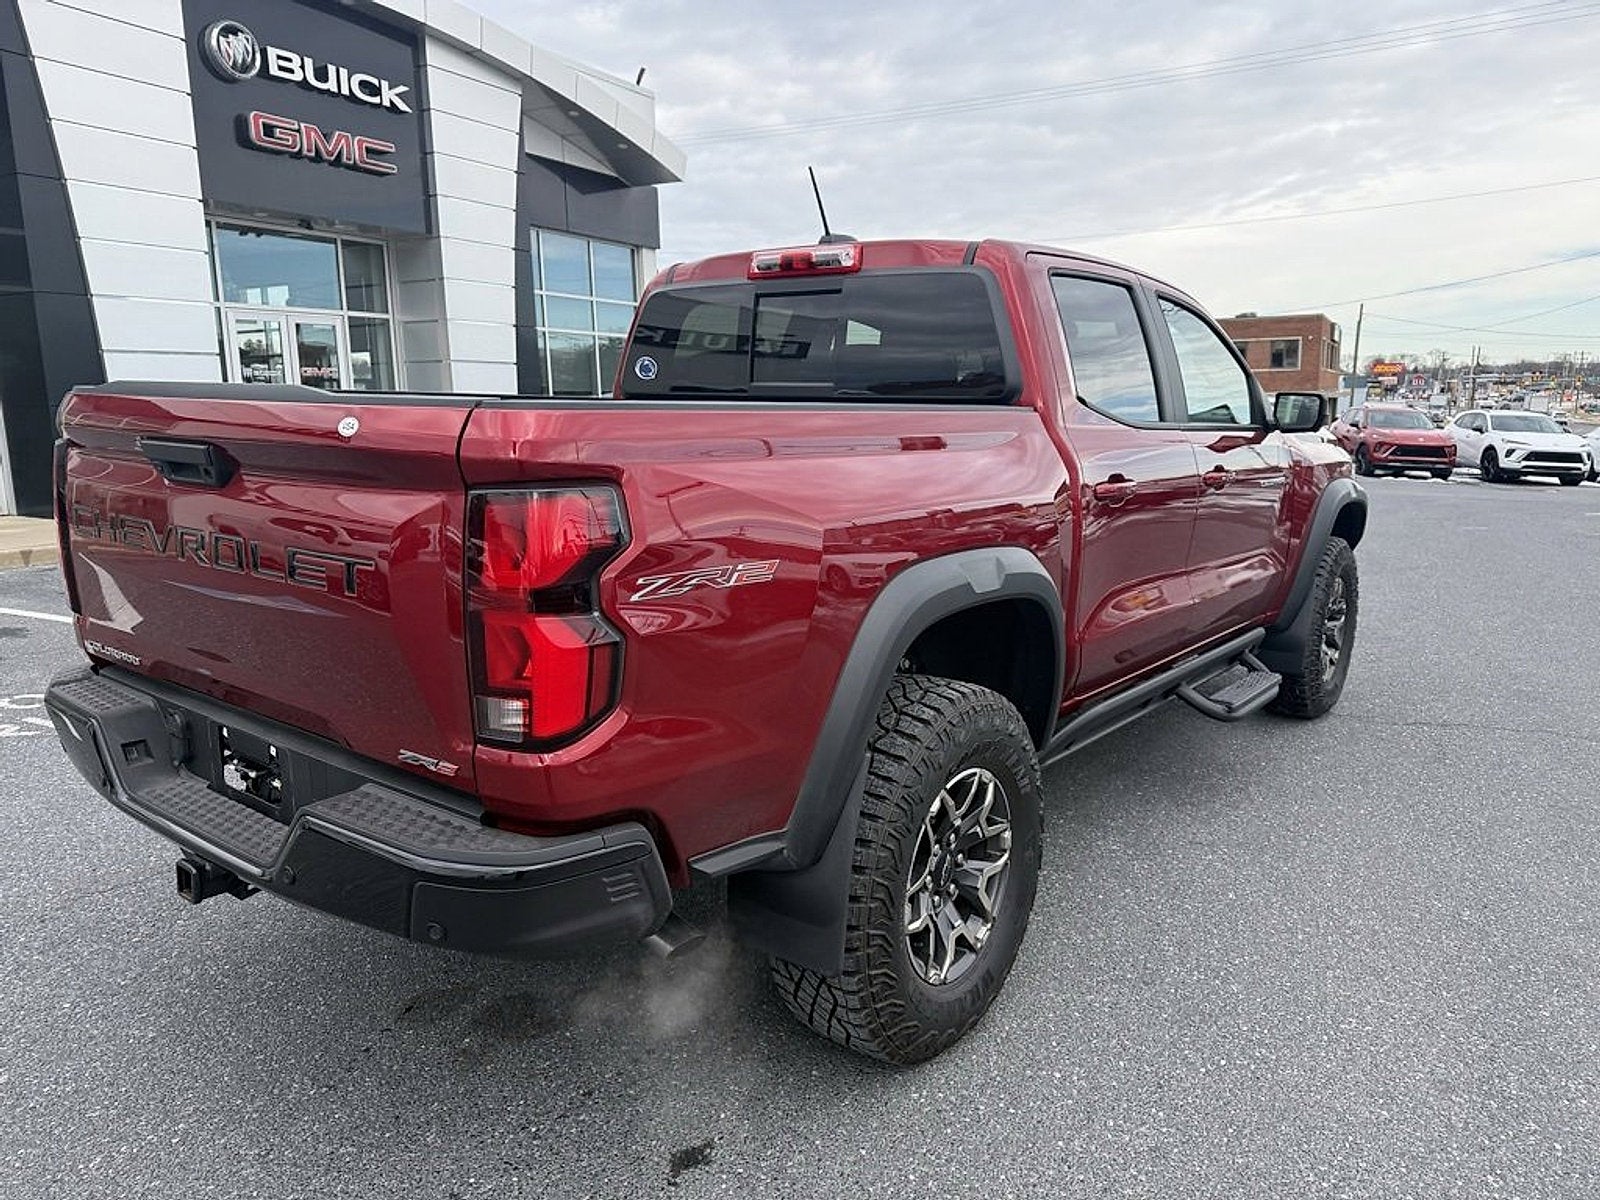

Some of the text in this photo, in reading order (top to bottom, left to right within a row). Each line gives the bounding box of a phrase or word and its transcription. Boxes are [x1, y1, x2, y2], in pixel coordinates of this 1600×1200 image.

[265, 45, 413, 114] BUICK
[250, 110, 398, 174] GMC
[72, 503, 376, 597] CHEVROLET
[630, 559, 780, 602] ZR2
[397, 748, 460, 777] ZR2
